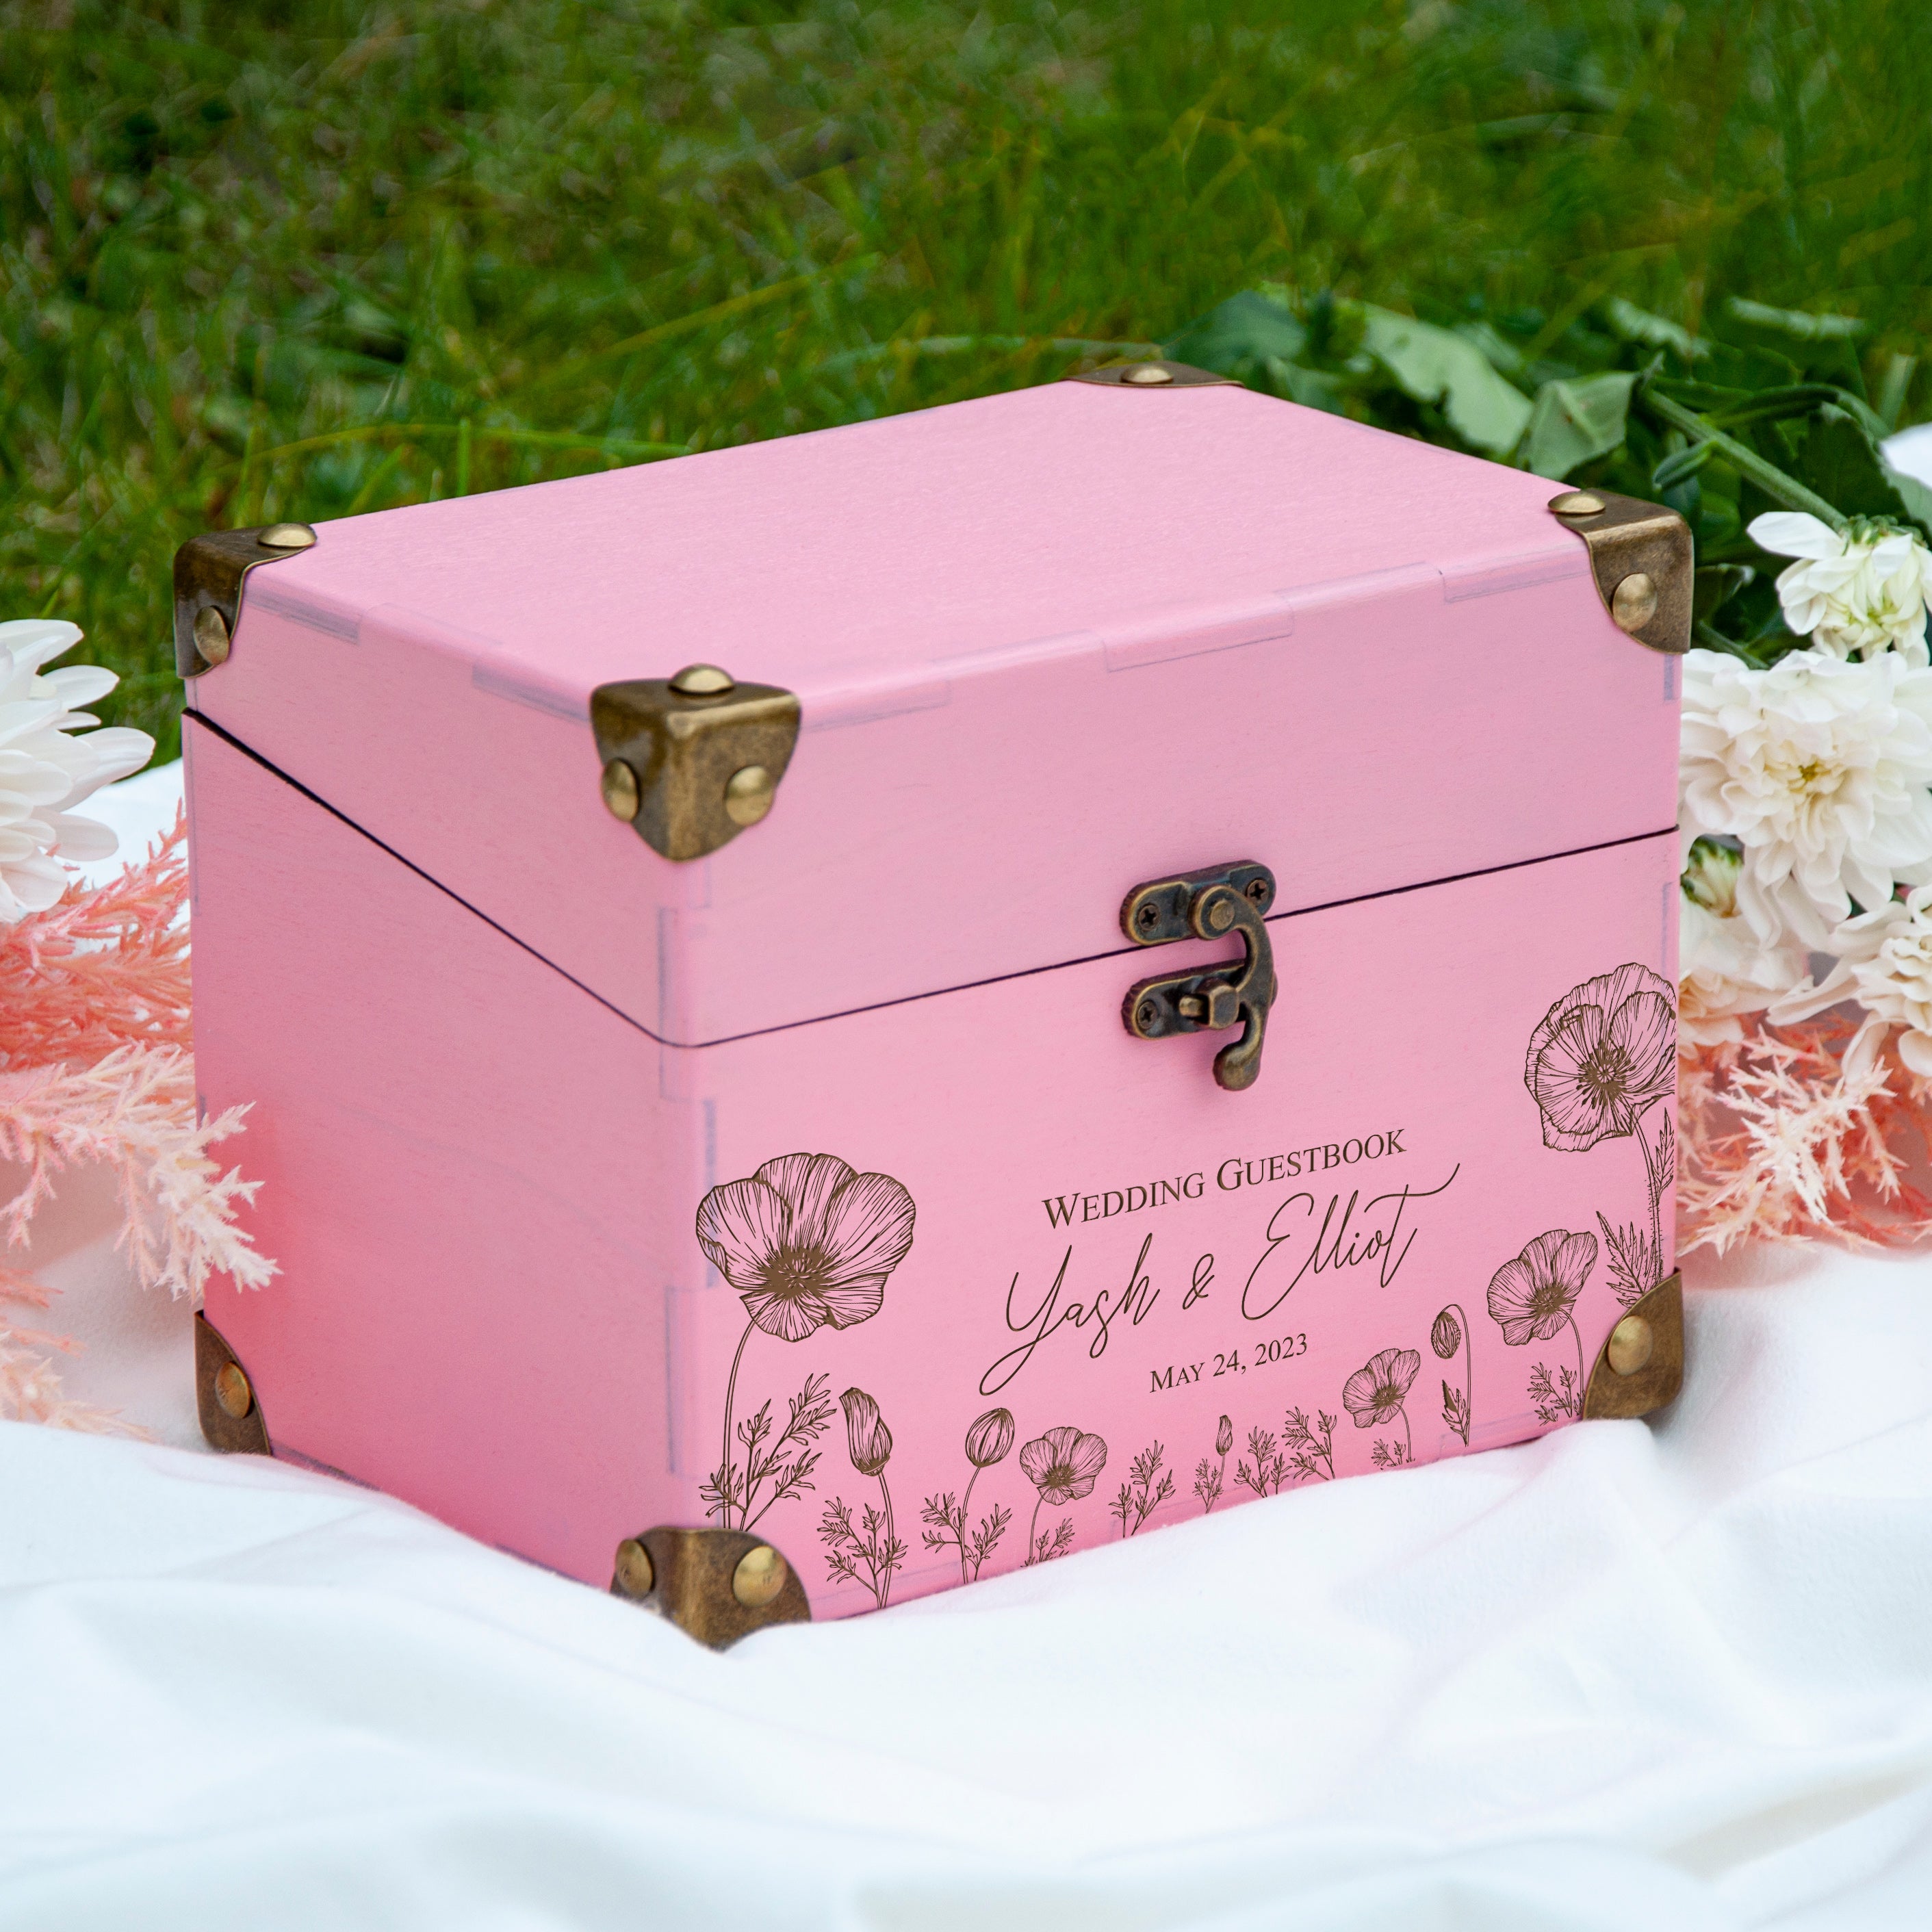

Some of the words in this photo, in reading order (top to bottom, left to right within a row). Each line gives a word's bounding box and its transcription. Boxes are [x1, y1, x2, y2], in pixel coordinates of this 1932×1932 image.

[1041, 1170, 1205, 1229] WEDDING
[1215, 1128, 1408, 1192] GUESTBOOK
[979, 1233, 1161, 1397] Yash
[1182, 1253, 1215, 1310] &
[1241, 1163, 1460, 1321] Elliot
[1149, 1361, 1205, 1393] MAY
[1212, 1349, 1247, 1377] 24,
[1254, 1332, 1308, 1367] 2023
